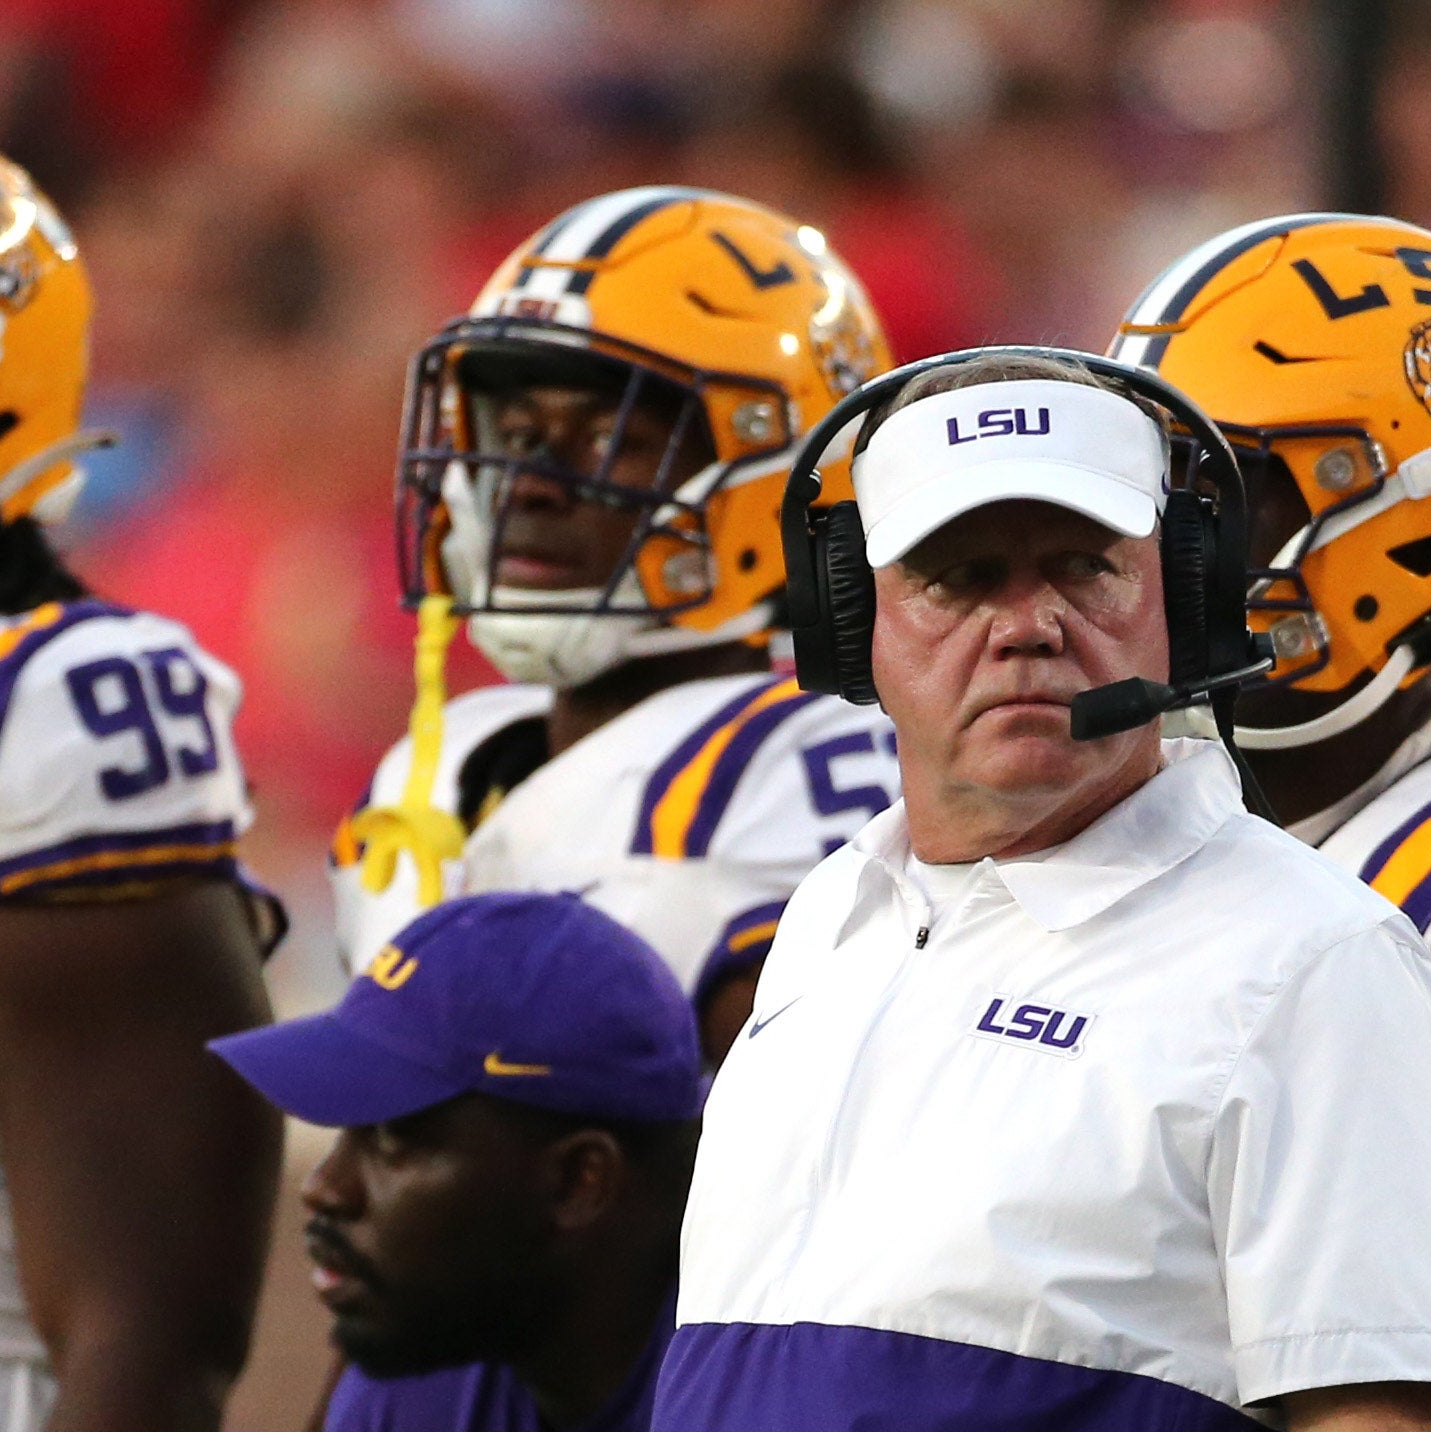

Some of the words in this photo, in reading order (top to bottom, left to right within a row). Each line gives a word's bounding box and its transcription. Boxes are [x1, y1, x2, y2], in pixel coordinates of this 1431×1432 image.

[947, 407, 1050, 446] LSU
[65, 648, 219, 801] 99
[803, 730, 898, 820] 5
[976, 998, 1088, 1049] LSU
